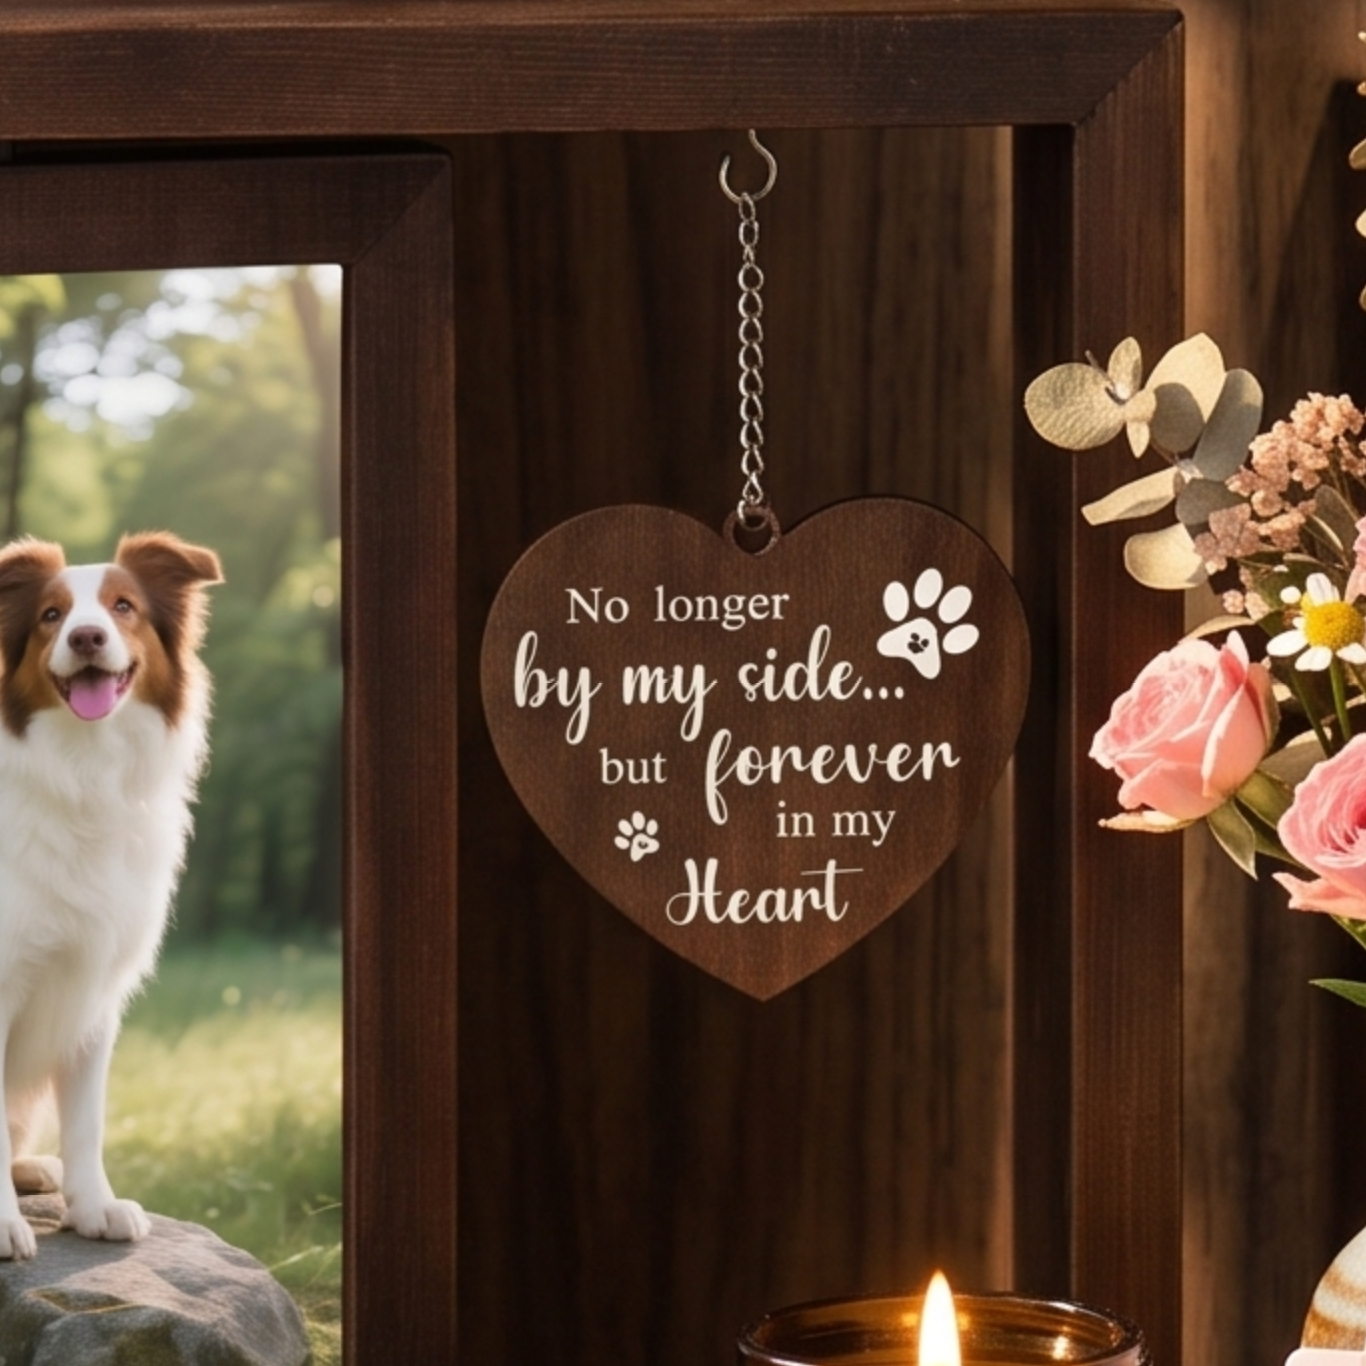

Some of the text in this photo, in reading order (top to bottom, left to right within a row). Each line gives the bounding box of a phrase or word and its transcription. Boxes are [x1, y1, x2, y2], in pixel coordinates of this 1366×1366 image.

[565, 585, 790, 631] No longer
[514, 624, 905, 746] by my side...
[599, 728, 961, 826] but forever
[776, 800, 896, 847] in my
[666, 857, 863, 926] Heart
